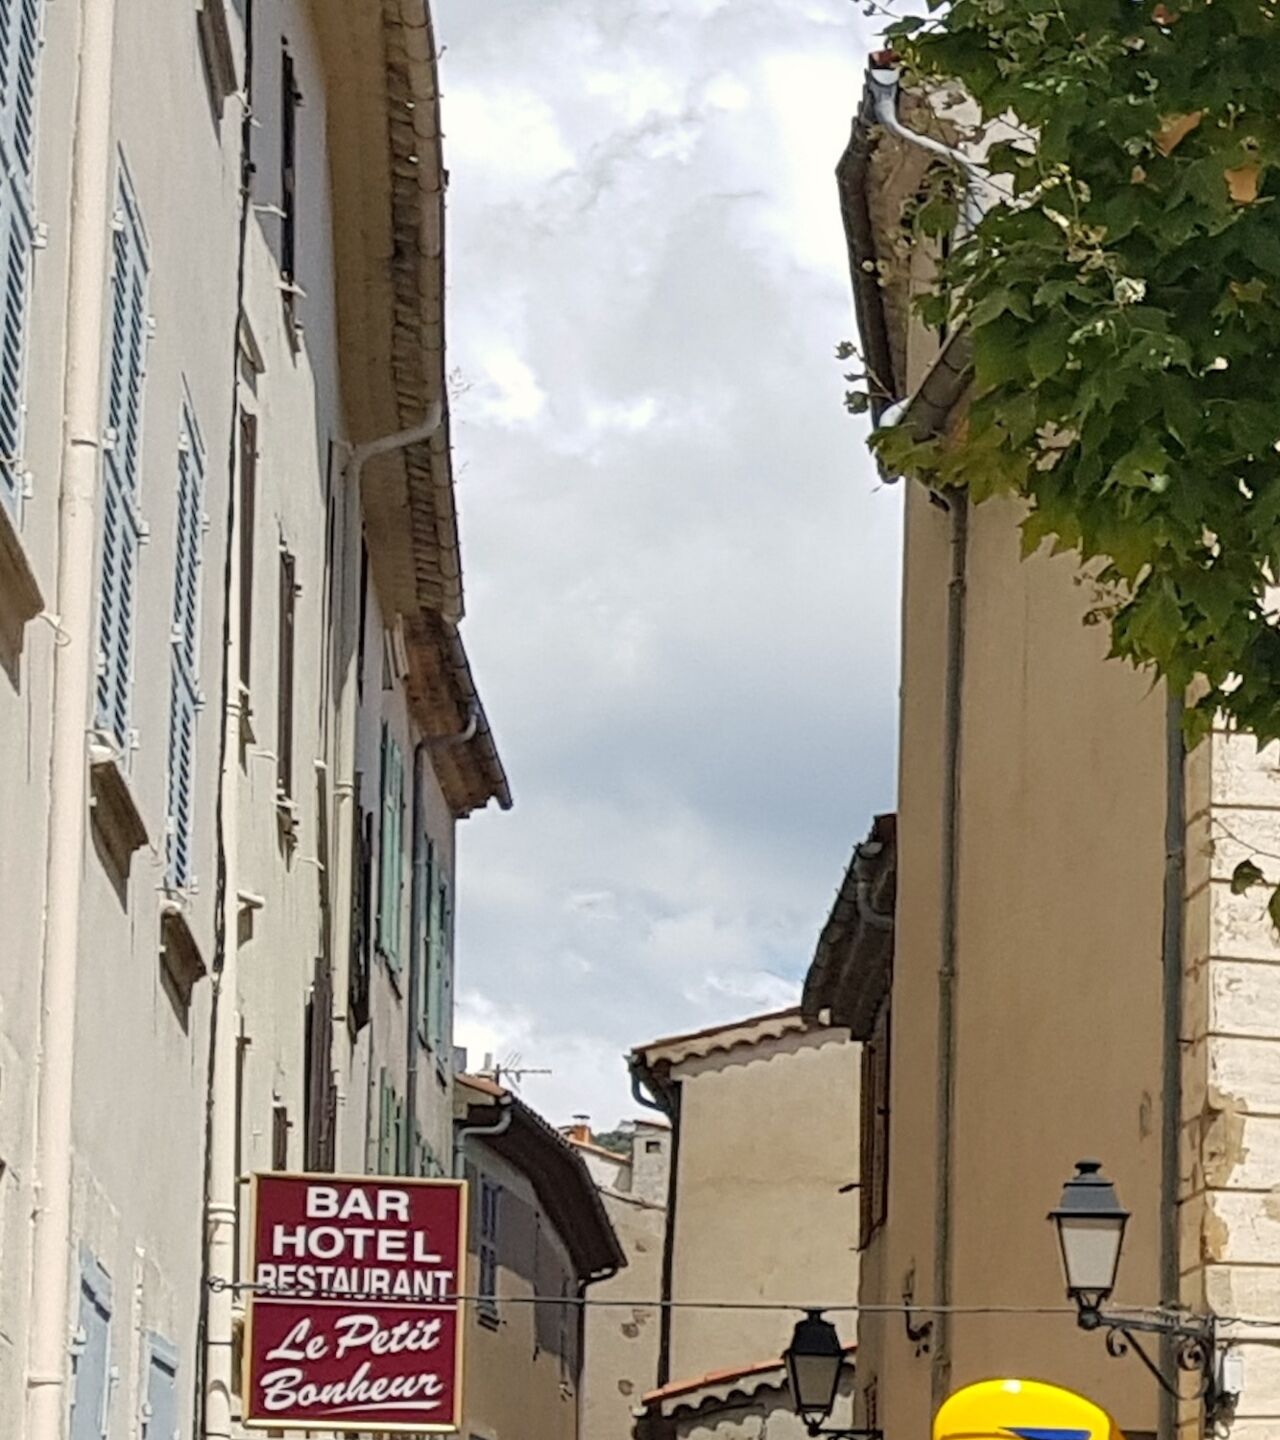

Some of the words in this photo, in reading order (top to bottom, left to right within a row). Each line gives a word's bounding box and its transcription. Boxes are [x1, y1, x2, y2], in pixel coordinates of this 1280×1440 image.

[306, 1186, 410, 1222] BAR
[272, 1225, 442, 1264] HOTEL
[256, 1263, 454, 1302] RESTAURANT
[265, 1317, 329, 1361] Le
[334, 1314, 442, 1359] Petit
[260, 1361, 444, 1411] Bonheur
